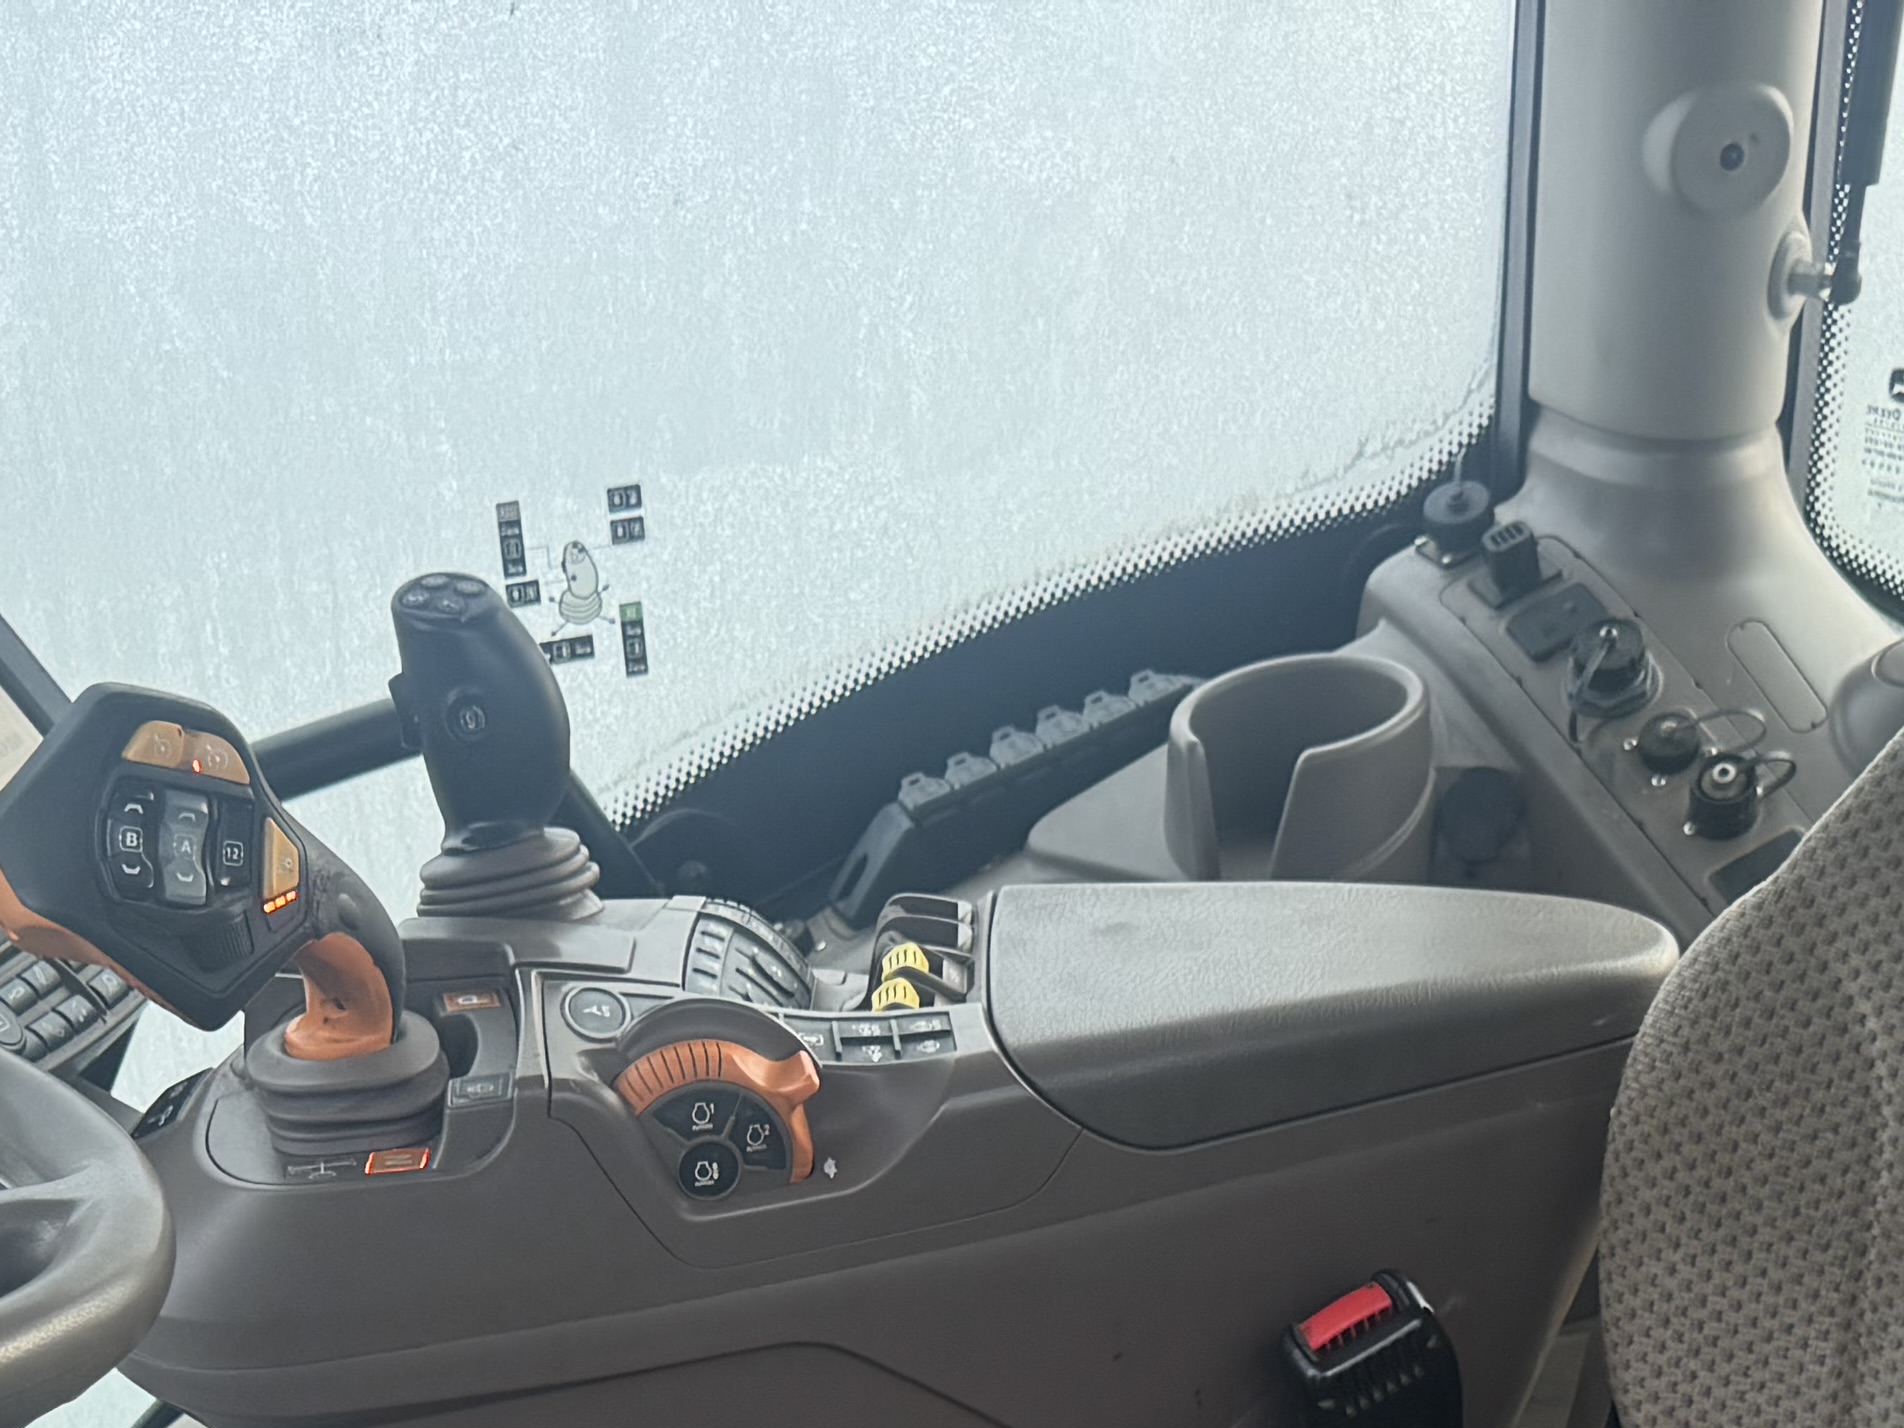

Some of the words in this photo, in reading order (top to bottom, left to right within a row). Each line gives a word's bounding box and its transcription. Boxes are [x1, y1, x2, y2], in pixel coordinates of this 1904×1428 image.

[126, 832, 137, 847] B
[181, 840, 192, 854] A
[227, 847, 239, 860] 12
[710, 1103, 715, 1114] 1
[763, 1124, 770, 1136] 2
